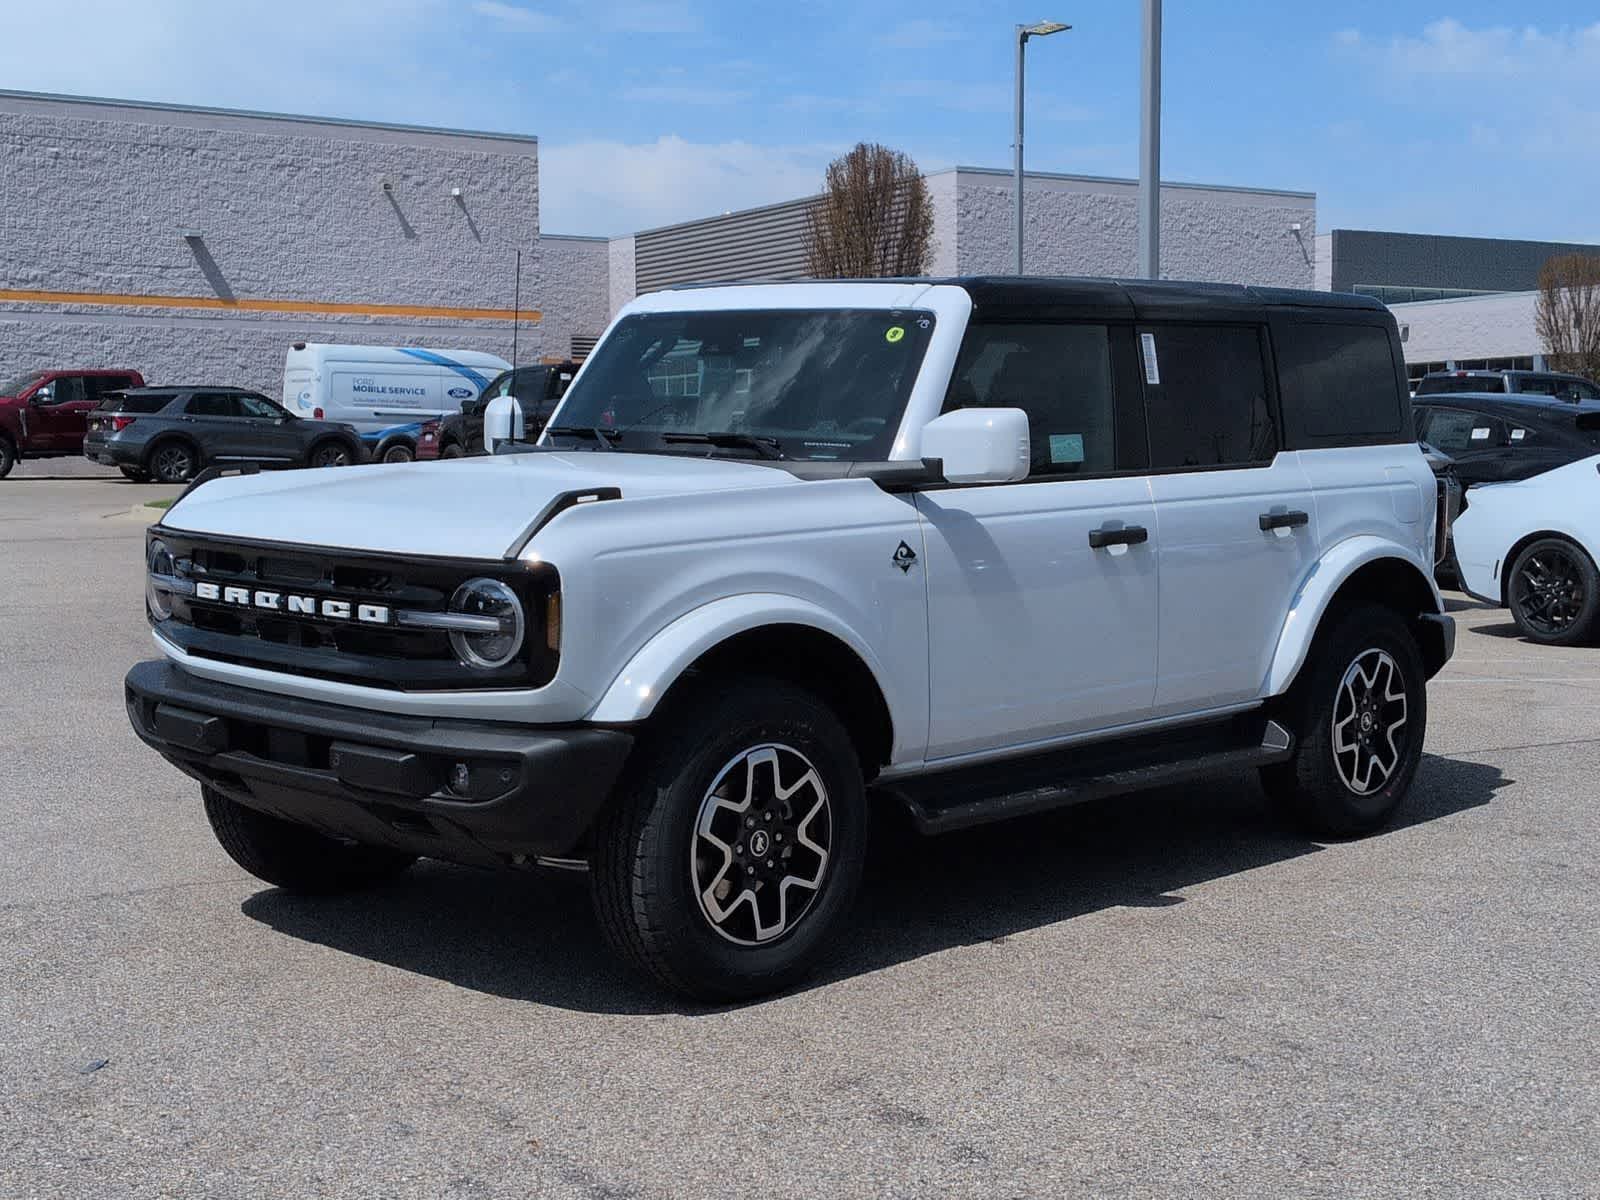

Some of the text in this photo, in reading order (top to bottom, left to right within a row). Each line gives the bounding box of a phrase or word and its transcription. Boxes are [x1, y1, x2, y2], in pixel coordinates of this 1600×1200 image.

[352, 377, 374, 385] FORD
[352, 385, 426, 396] MOBILE SERVICE
[196, 582, 389, 623] BRONCO
